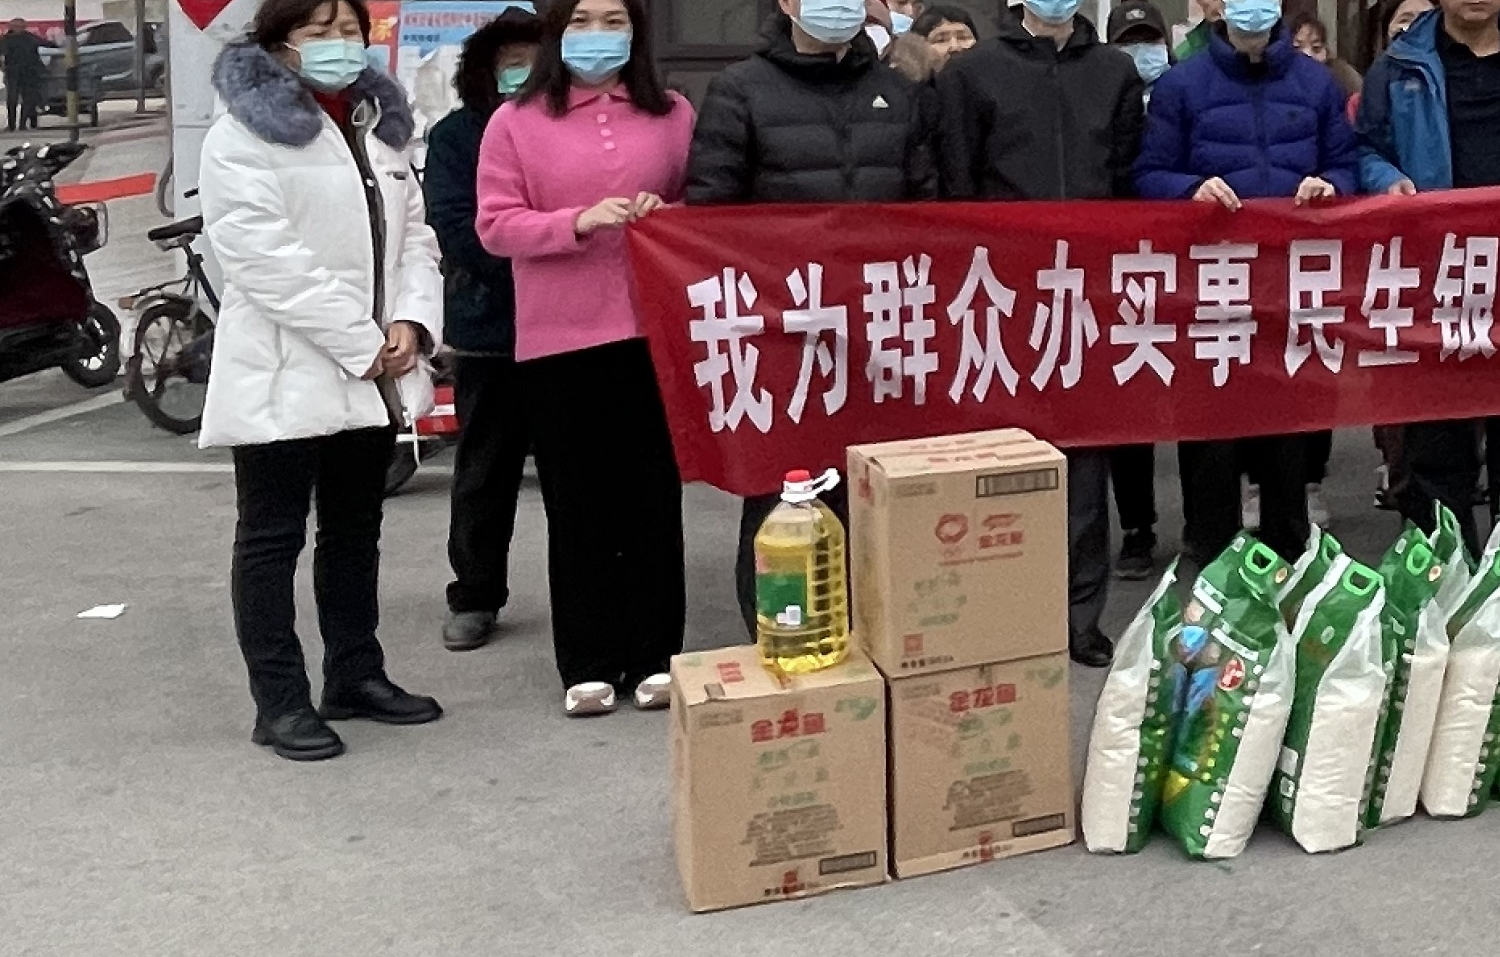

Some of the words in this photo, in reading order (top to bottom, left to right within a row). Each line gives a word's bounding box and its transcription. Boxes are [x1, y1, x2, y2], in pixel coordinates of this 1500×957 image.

[687, 239, 1258, 434] 我为群众办实事
